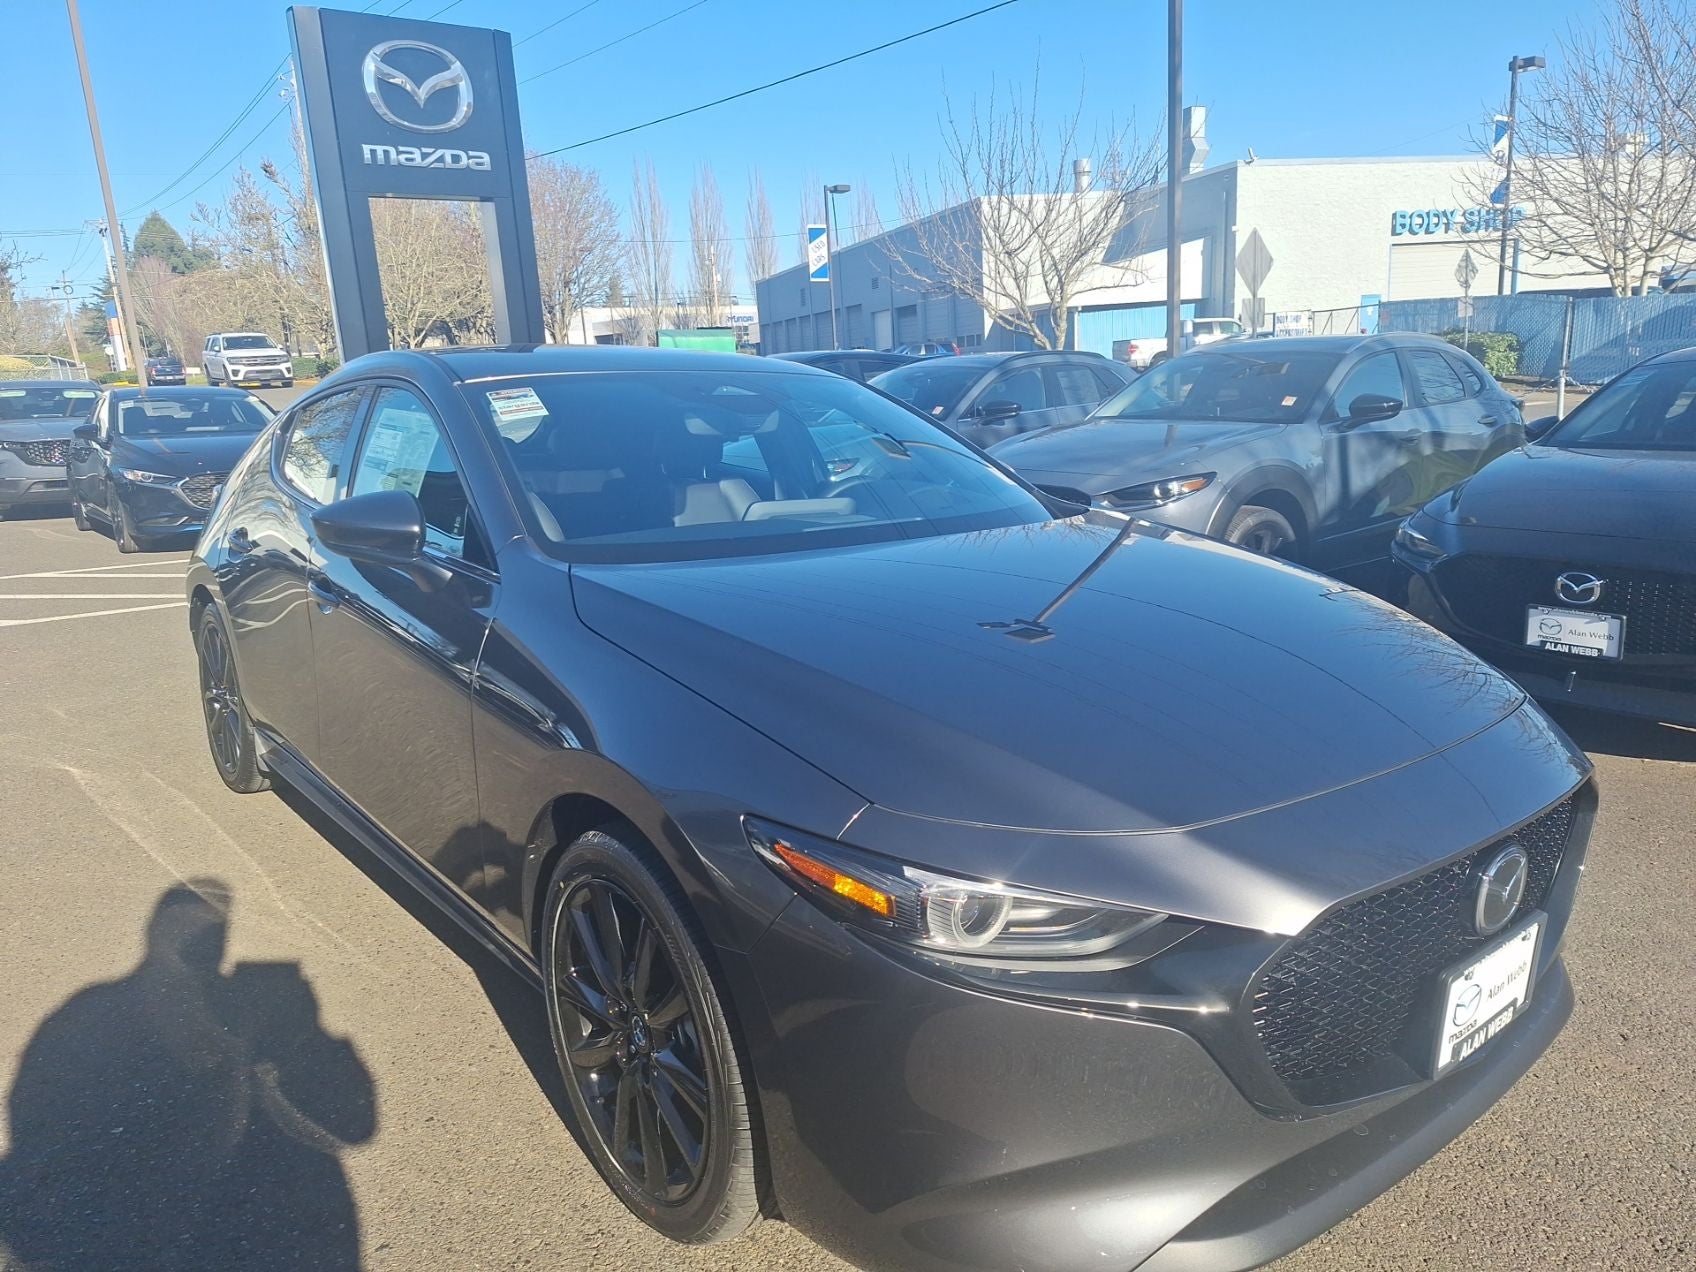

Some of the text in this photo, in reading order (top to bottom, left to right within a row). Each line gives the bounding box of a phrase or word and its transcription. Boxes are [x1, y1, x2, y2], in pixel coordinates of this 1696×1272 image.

[361, 143, 492, 171] mazda
[1391, 208, 1457, 236] BODY
[1568, 629, 1614, 641] Alan Webb
[1544, 642, 1599, 657] ALAN WEBB
[1487, 961, 1527, 999] Alan Webb
[1459, 1007, 1513, 1062] ALAN WEBB
